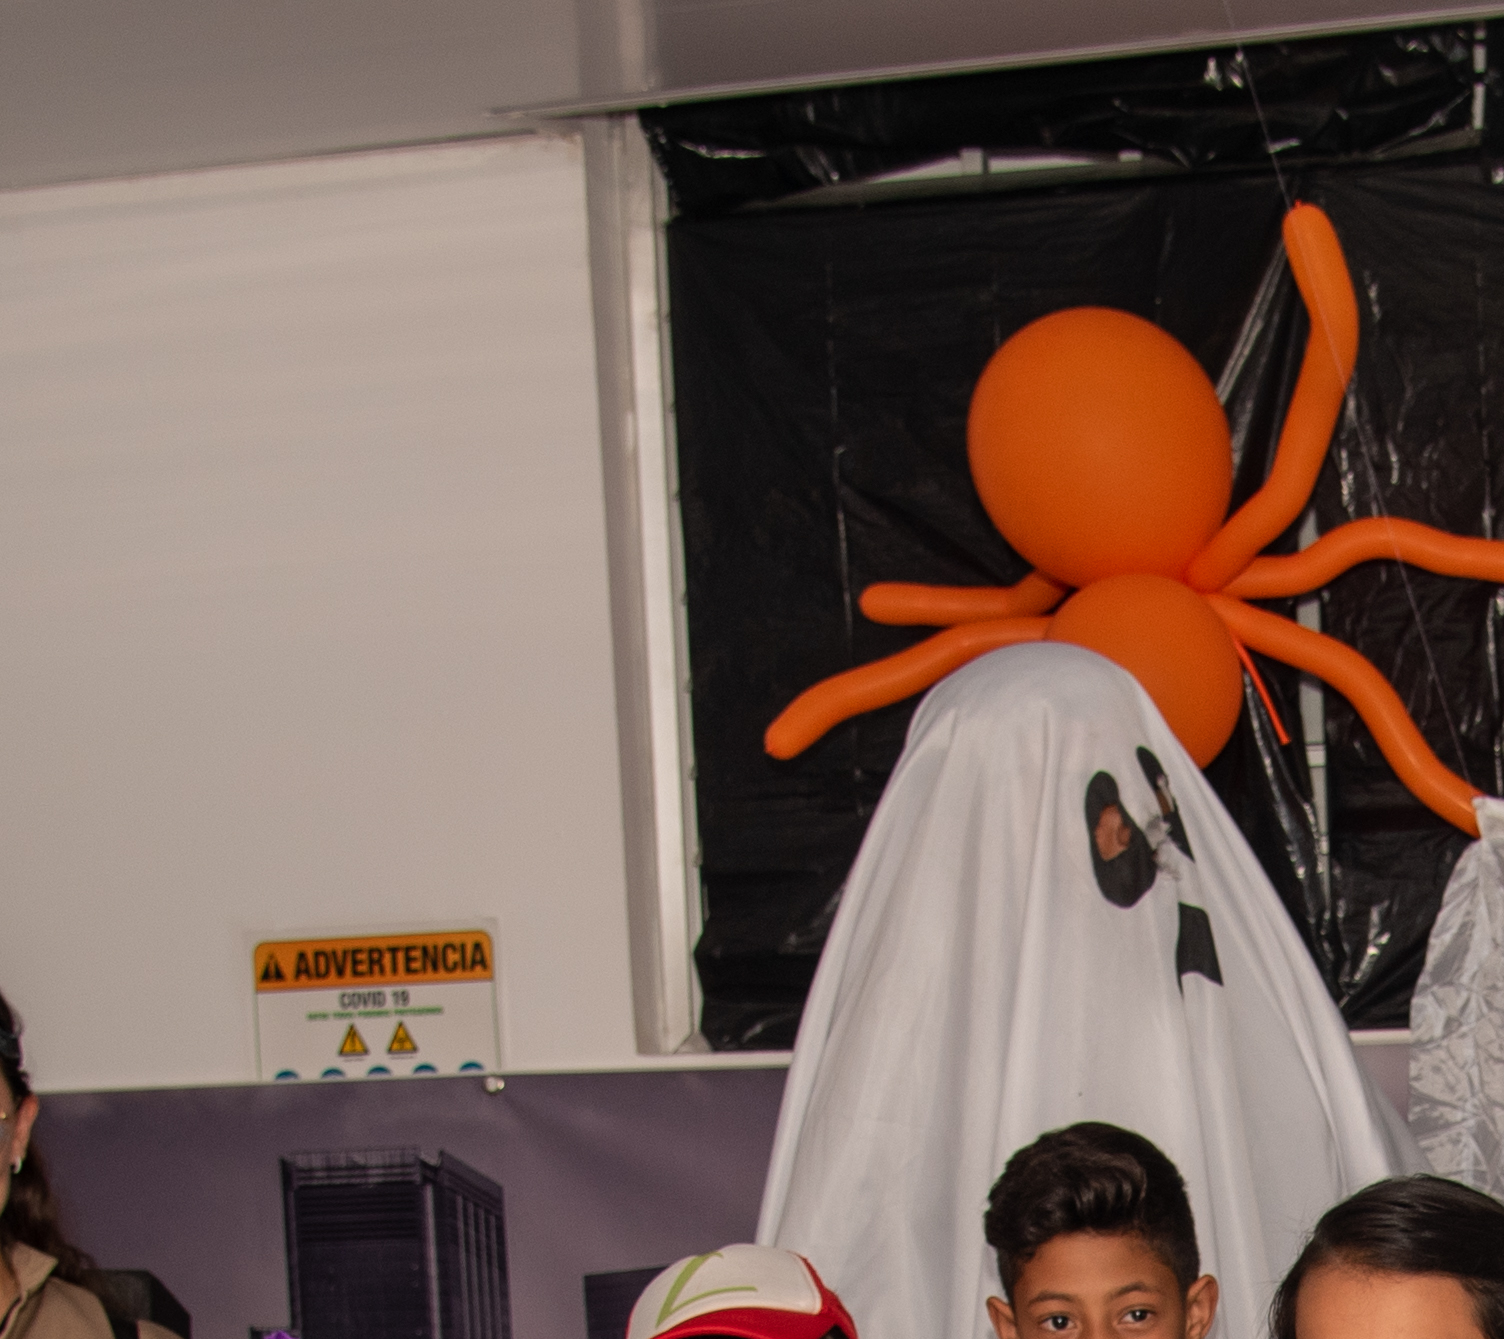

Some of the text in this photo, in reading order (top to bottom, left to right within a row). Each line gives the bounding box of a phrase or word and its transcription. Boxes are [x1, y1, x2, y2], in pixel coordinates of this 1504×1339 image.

[293, 940, 488, 981] ADVERTENCIA
[338, 989, 411, 1009] COVID 19
